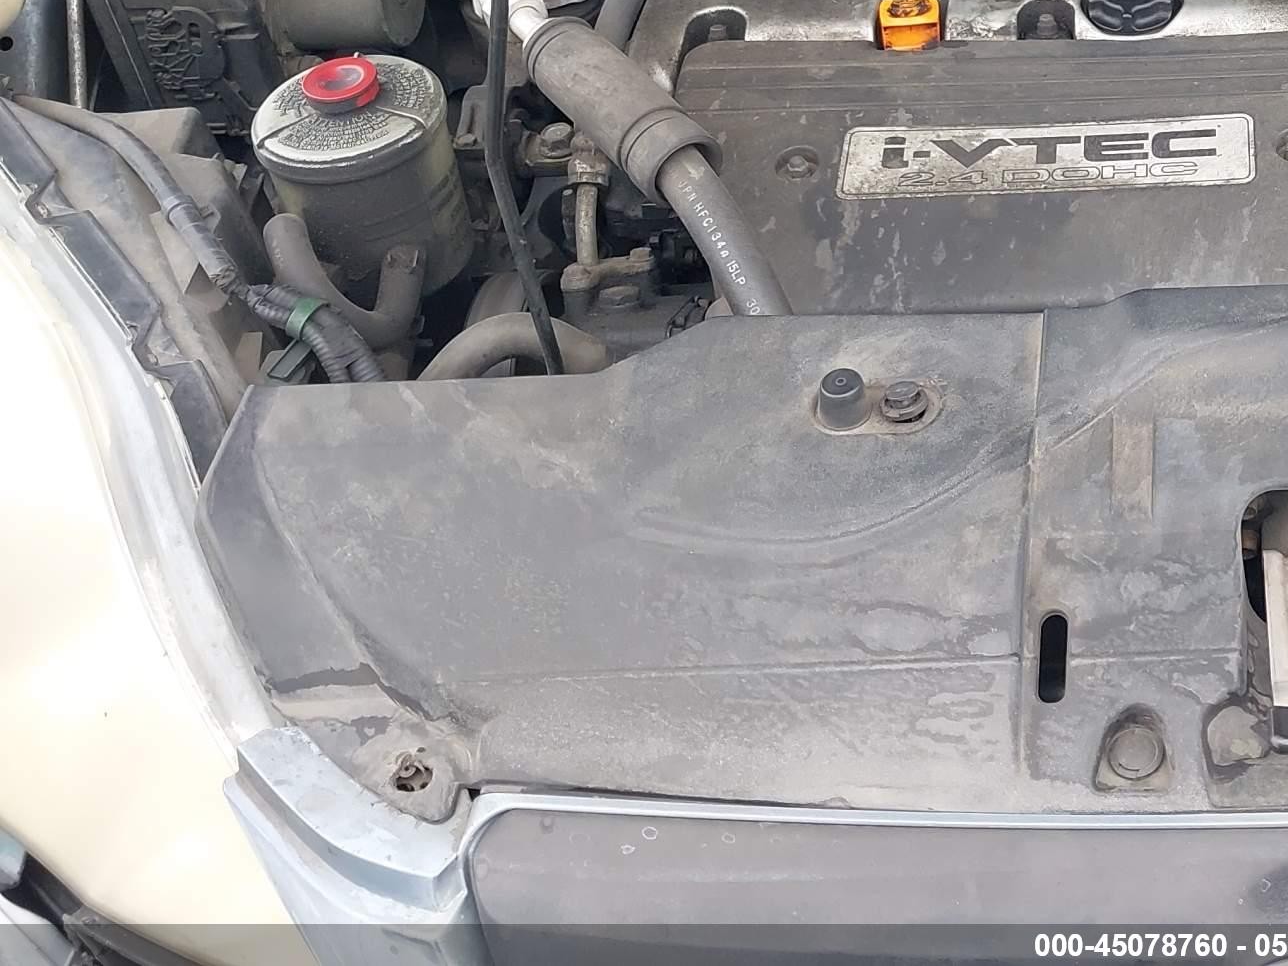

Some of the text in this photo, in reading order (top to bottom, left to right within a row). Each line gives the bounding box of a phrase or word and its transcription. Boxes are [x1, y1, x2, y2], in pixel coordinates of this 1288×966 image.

[881, 128, 1217, 169] i-VTEC
[898, 161, 1198, 187] 2.4 DOHC
[678, 180, 698, 202] JPN
[726, 259, 746, 286] 15LP
